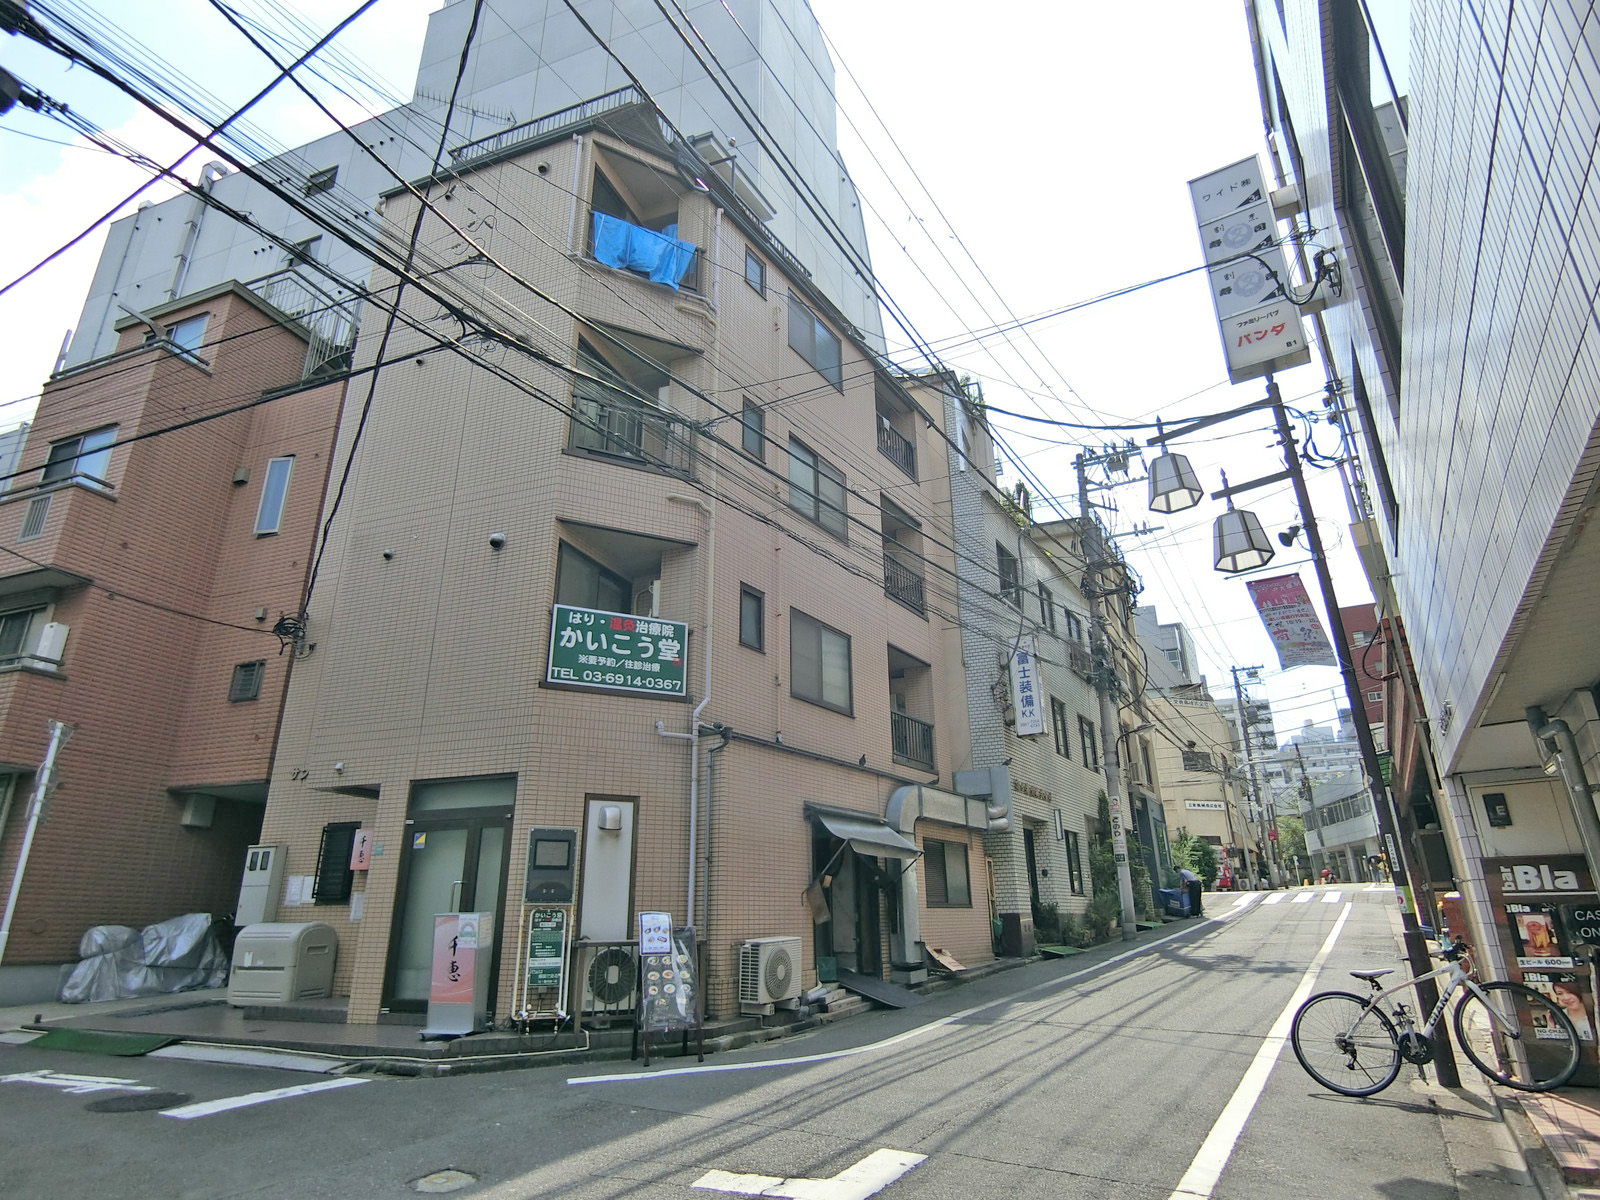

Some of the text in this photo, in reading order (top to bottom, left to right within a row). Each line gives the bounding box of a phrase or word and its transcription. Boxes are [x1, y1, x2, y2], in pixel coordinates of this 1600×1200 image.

[569, 611, 675, 638] はり・温灸治療院
[560, 627, 681, 662] かいこう堂
[552, 667, 682, 691] TEL 03-6914-0367
[1016, 652, 1034, 708] 富士装備
[1500, 864, 1579, 891] bar Bla
[1545, 958, 1562, 966] 600
[1429, 987, 1452, 1027] GIANT
